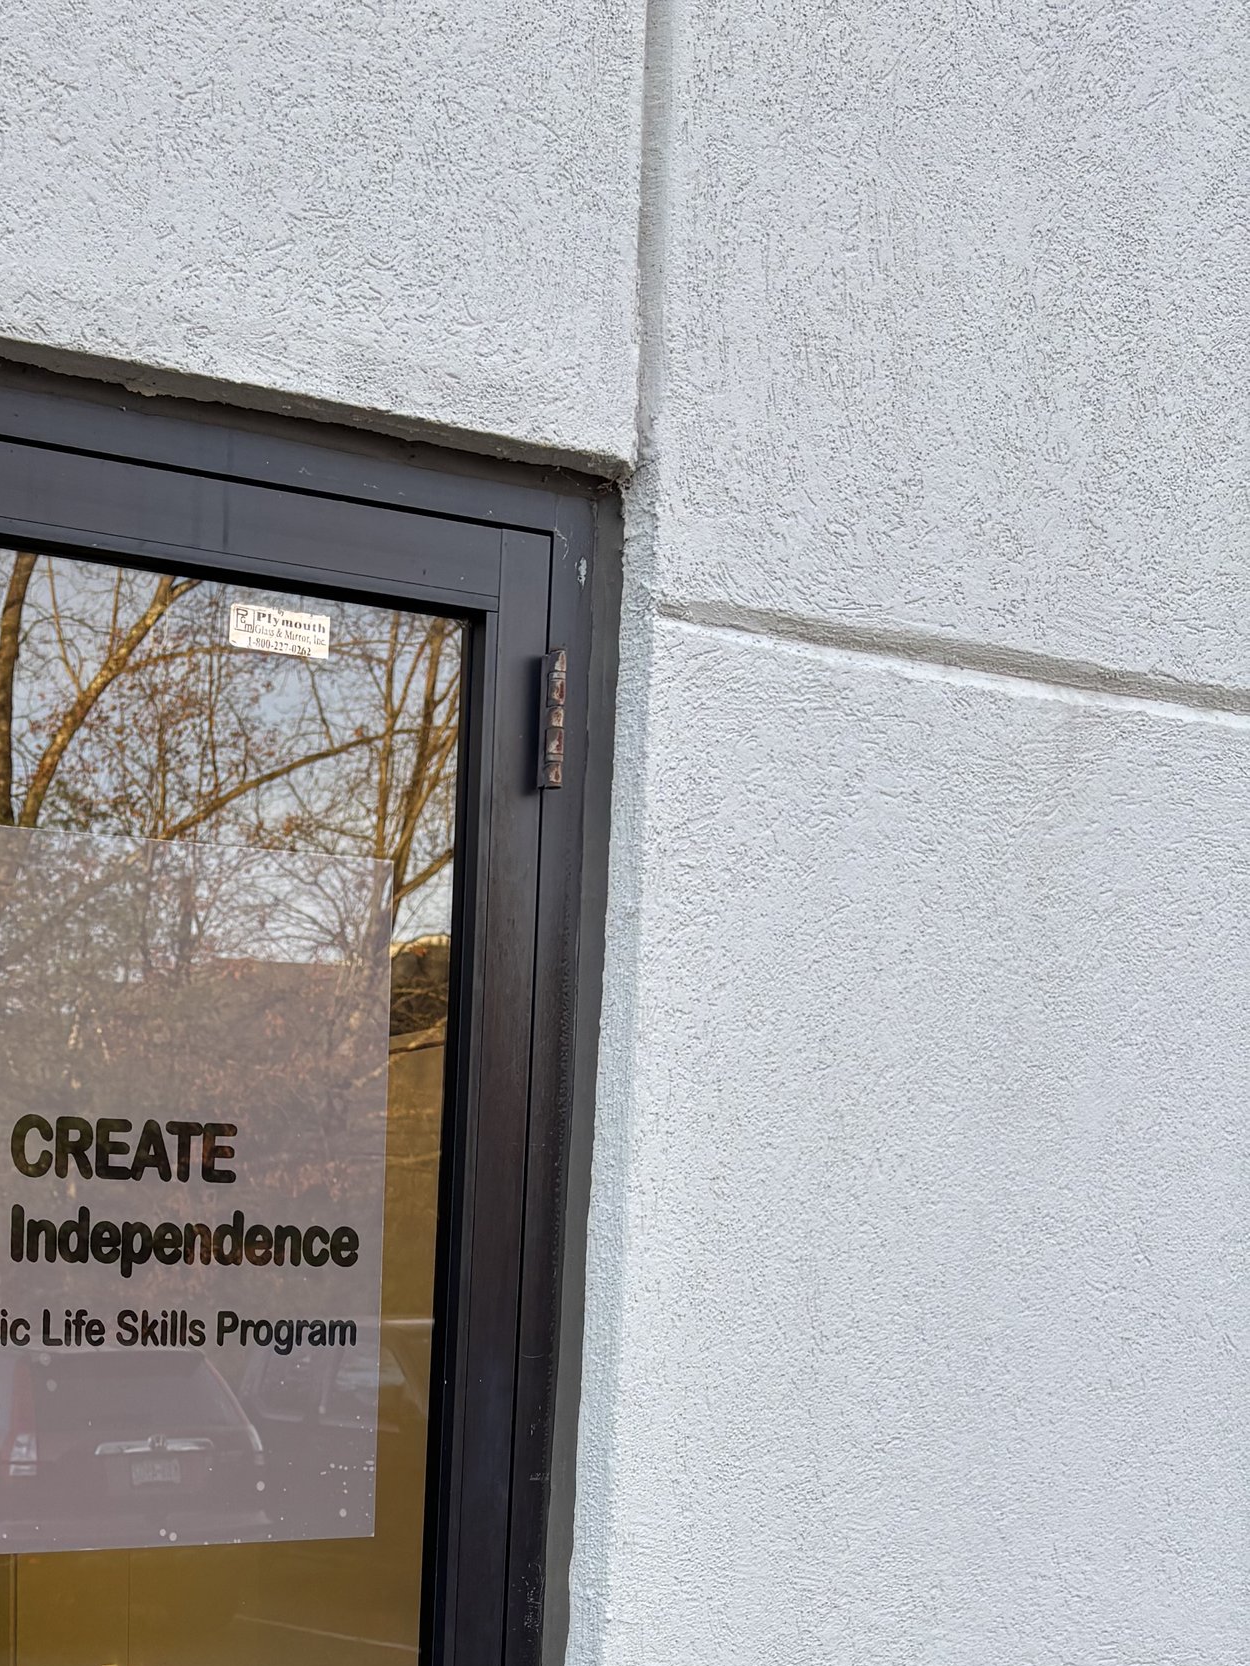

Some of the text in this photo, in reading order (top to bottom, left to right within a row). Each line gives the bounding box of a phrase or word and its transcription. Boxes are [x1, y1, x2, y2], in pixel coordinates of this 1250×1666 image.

[254, 625, 275, 637] Glass
[276, 628, 283, 638] &
[256, 612, 326, 634] Plymouth
[248, 636, 312, 656] 1-800-227-0262
[11, 1114, 238, 1184] CREATE
[10, 1204, 360, 1278] Independence
[42, 1308, 106, 1347] Life
[116, 1309, 206, 1347] Skills
[216, 1310, 357, 1355] Program
